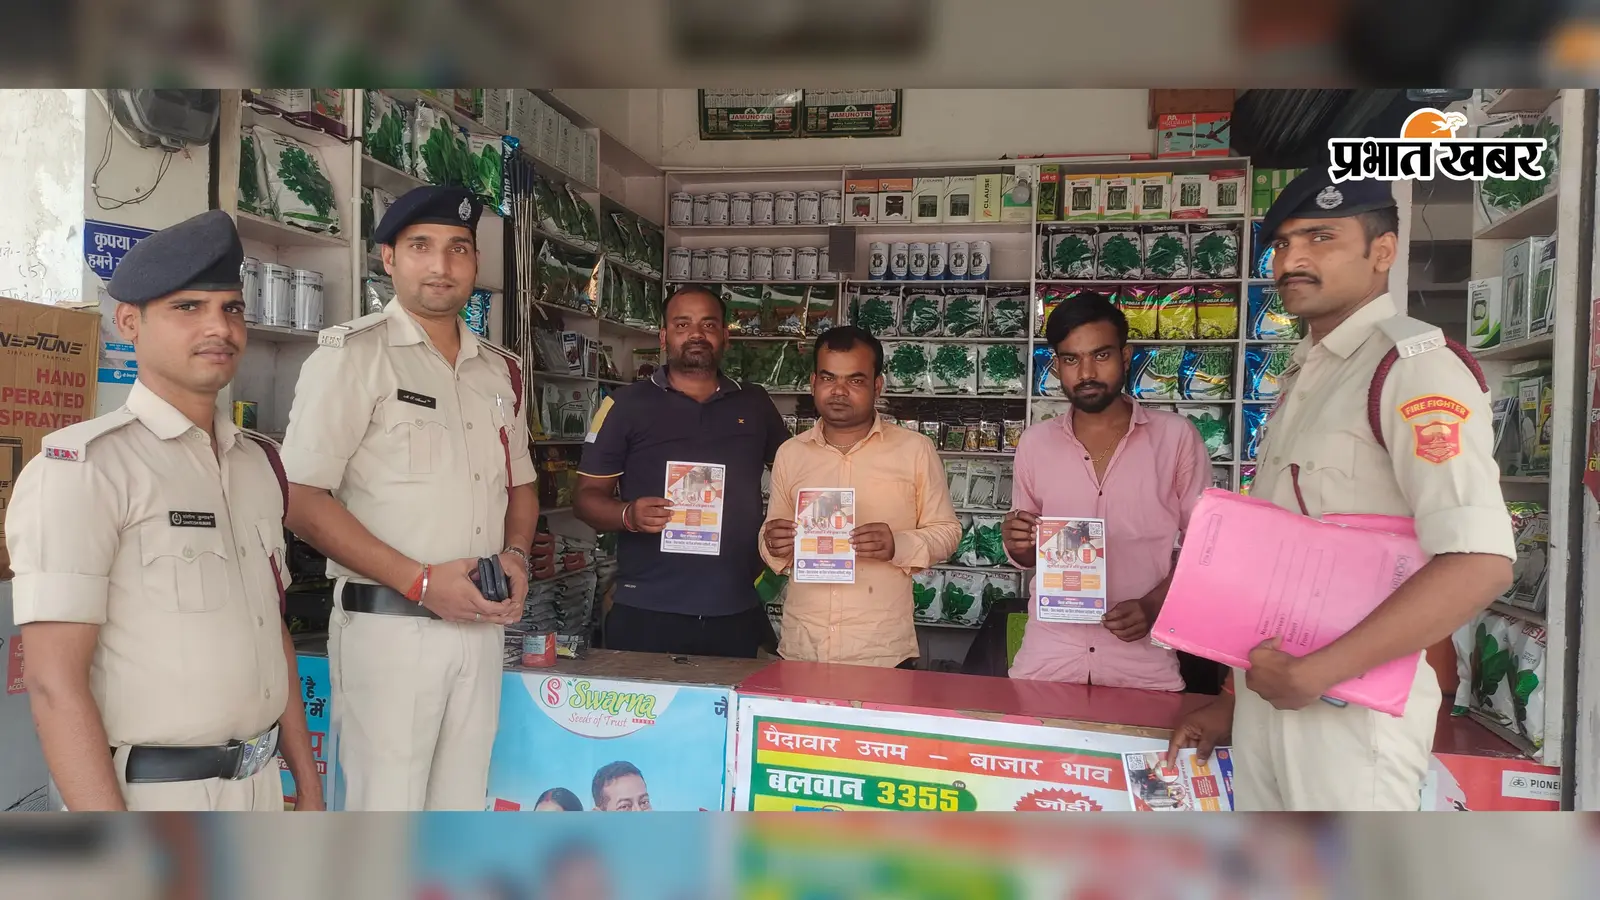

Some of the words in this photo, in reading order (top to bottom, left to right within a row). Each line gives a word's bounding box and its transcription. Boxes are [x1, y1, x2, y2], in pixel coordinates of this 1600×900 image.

[729, 113, 773, 121] JAMUNOTRI
[829, 111, 873, 119] JAMUNOTRI
[94, 231, 131, 252] कृपया
[87, 252, 113, 270] हमने
[0, 332, 83, 355] NEPTUNE
[36, 367, 86, 388] HAND
[1405, 402, 1426, 416] FIRE
[1427, 399, 1467, 416] FIGHTER
[568, 680, 657, 719] Swarna
[568, 712, 591, 725] Seeds
[592, 713, 603, 728] of
[604, 715, 628, 728] Trust
[763, 724, 841, 753] पैदावार
[855, 739, 909, 761] उत्तम
[968, 752, 1044, 776] बाजार
[1061, 762, 1113, 784] भाव
[766, 768, 867, 801] बलवान
[877, 781, 960, 812] 3355
[1530, 779, 1560, 790] PIONE
